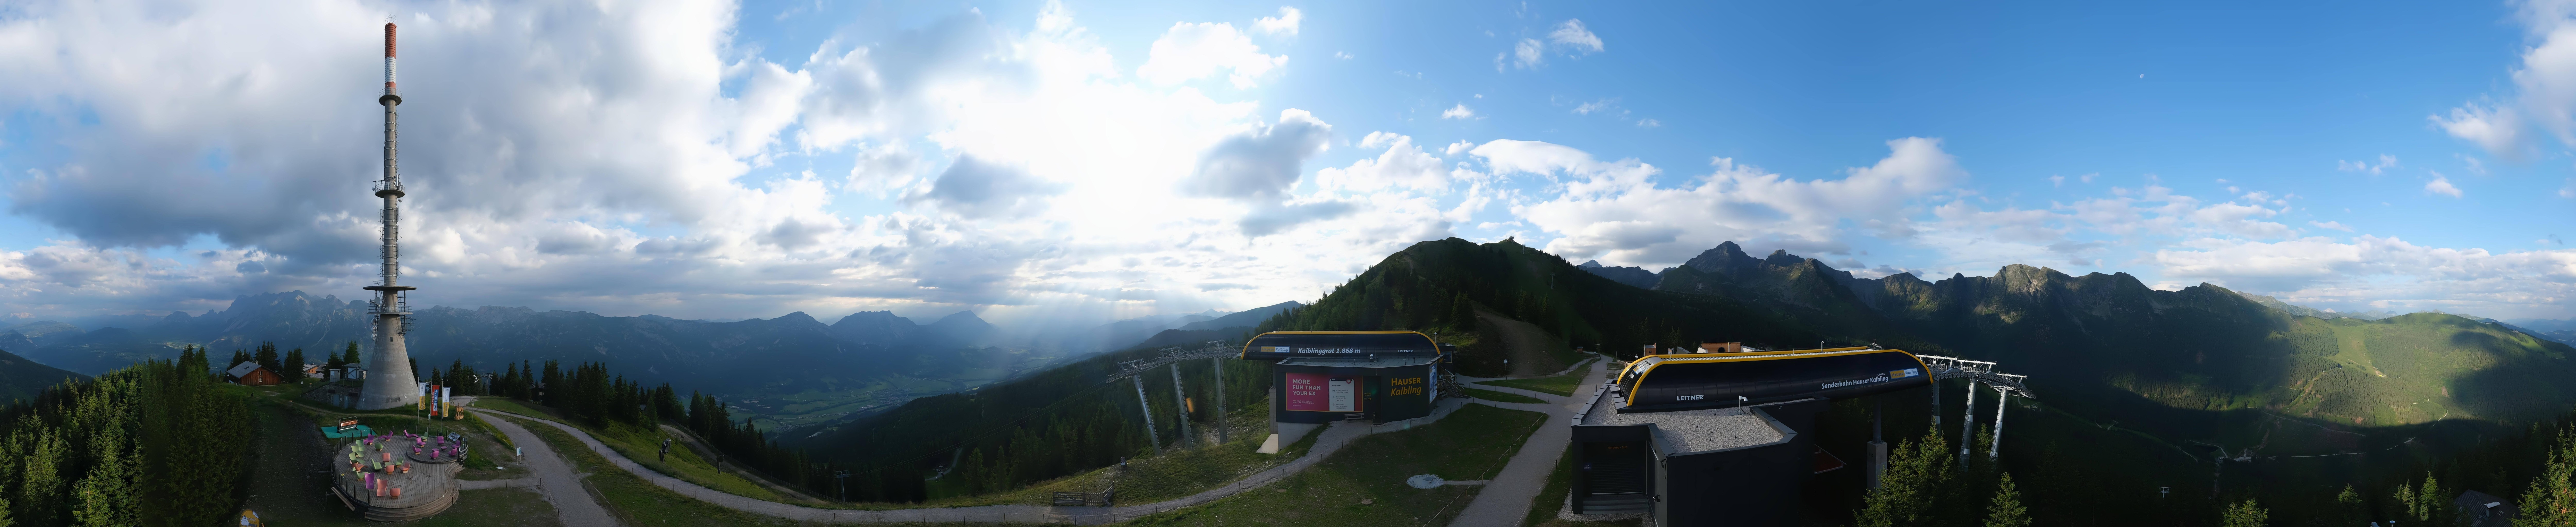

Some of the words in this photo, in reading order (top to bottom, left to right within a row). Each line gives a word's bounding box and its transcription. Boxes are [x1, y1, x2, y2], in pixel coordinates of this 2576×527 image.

[1391, 377, 1421, 386] HAUSER
[1822, 380, 1852, 389] Senderbahn
[1391, 386, 1421, 396] Kaibling
